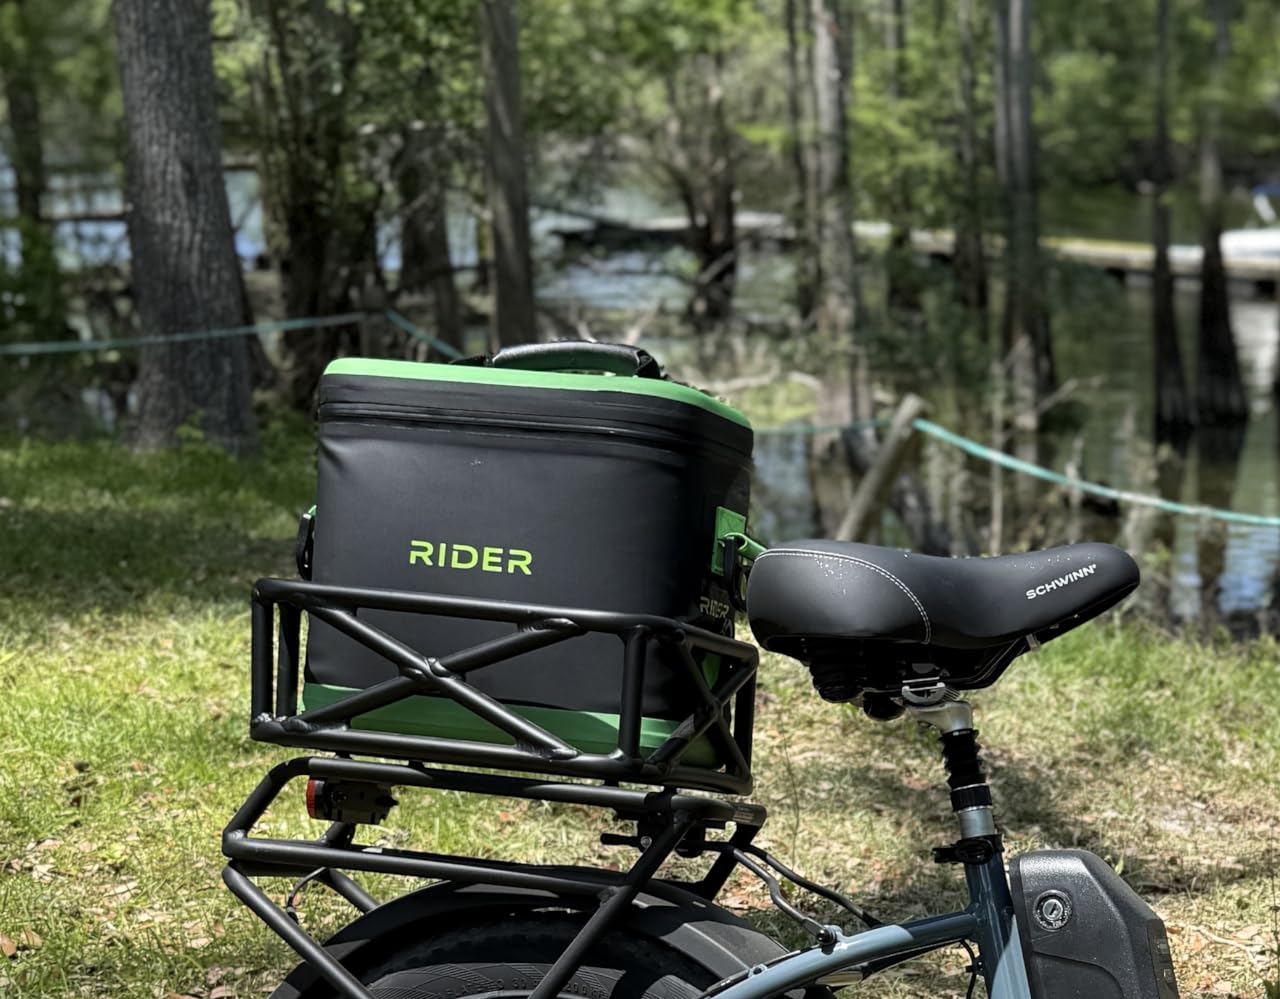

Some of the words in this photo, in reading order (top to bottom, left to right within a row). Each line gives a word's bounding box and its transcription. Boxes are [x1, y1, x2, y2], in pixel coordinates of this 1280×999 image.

[409, 540, 532, 575] RIDER
[1026, 564, 1096, 599] SCHWINN
[699, 595, 730, 619] RIDER
